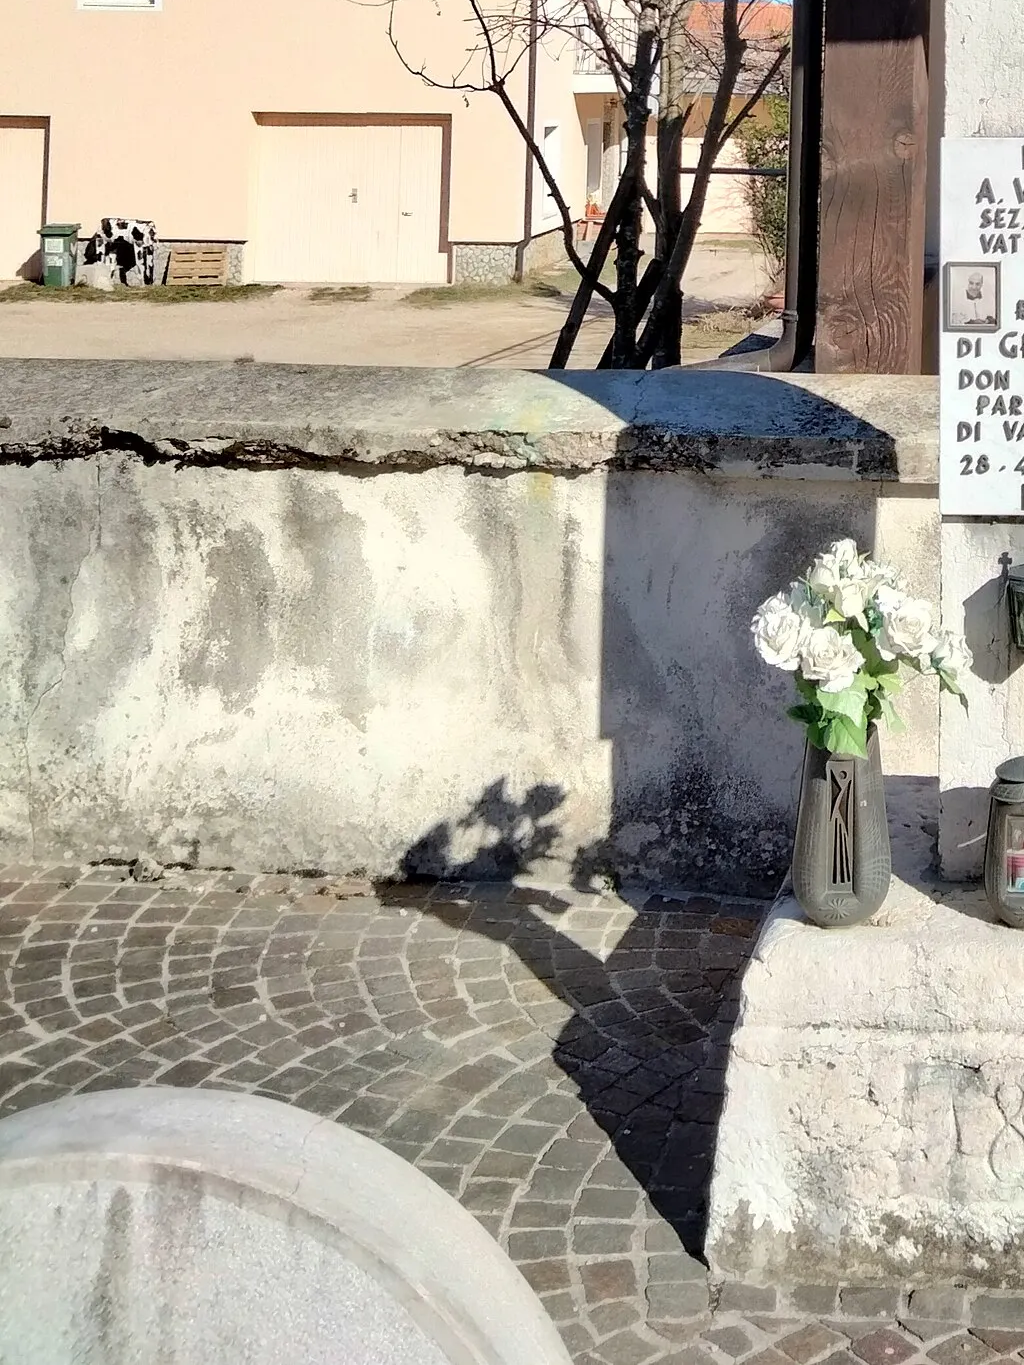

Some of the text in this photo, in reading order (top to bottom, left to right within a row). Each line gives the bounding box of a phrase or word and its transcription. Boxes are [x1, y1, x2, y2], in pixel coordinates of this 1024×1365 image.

[956, 337, 982, 359] DI
[958, 369, 1011, 391] DON
[956, 421, 982, 443] DI
